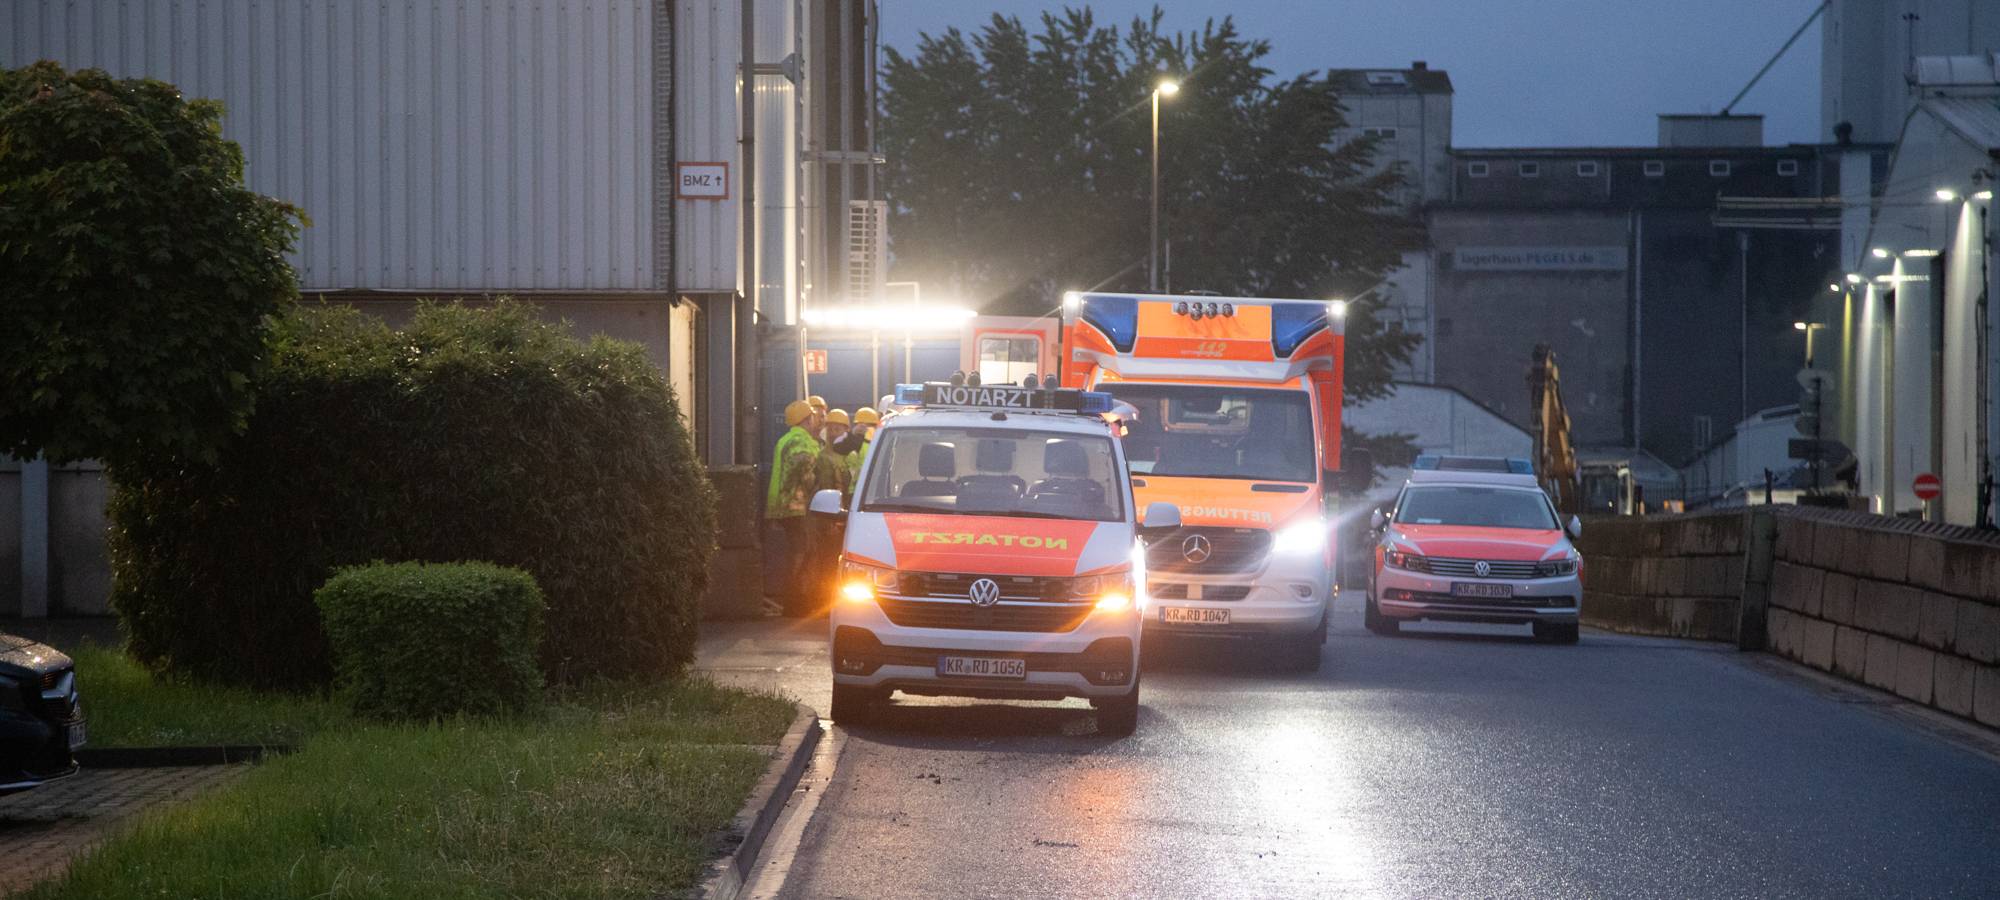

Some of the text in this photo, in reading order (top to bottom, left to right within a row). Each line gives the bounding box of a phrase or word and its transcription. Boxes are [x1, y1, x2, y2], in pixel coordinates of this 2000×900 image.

[683, 175, 710, 186] BMZ
[936, 386, 1036, 408] NOTARZT
[1166, 608, 1228, 622] KR RD 1047
[946, 659, 1023, 675] KR RD 1056
